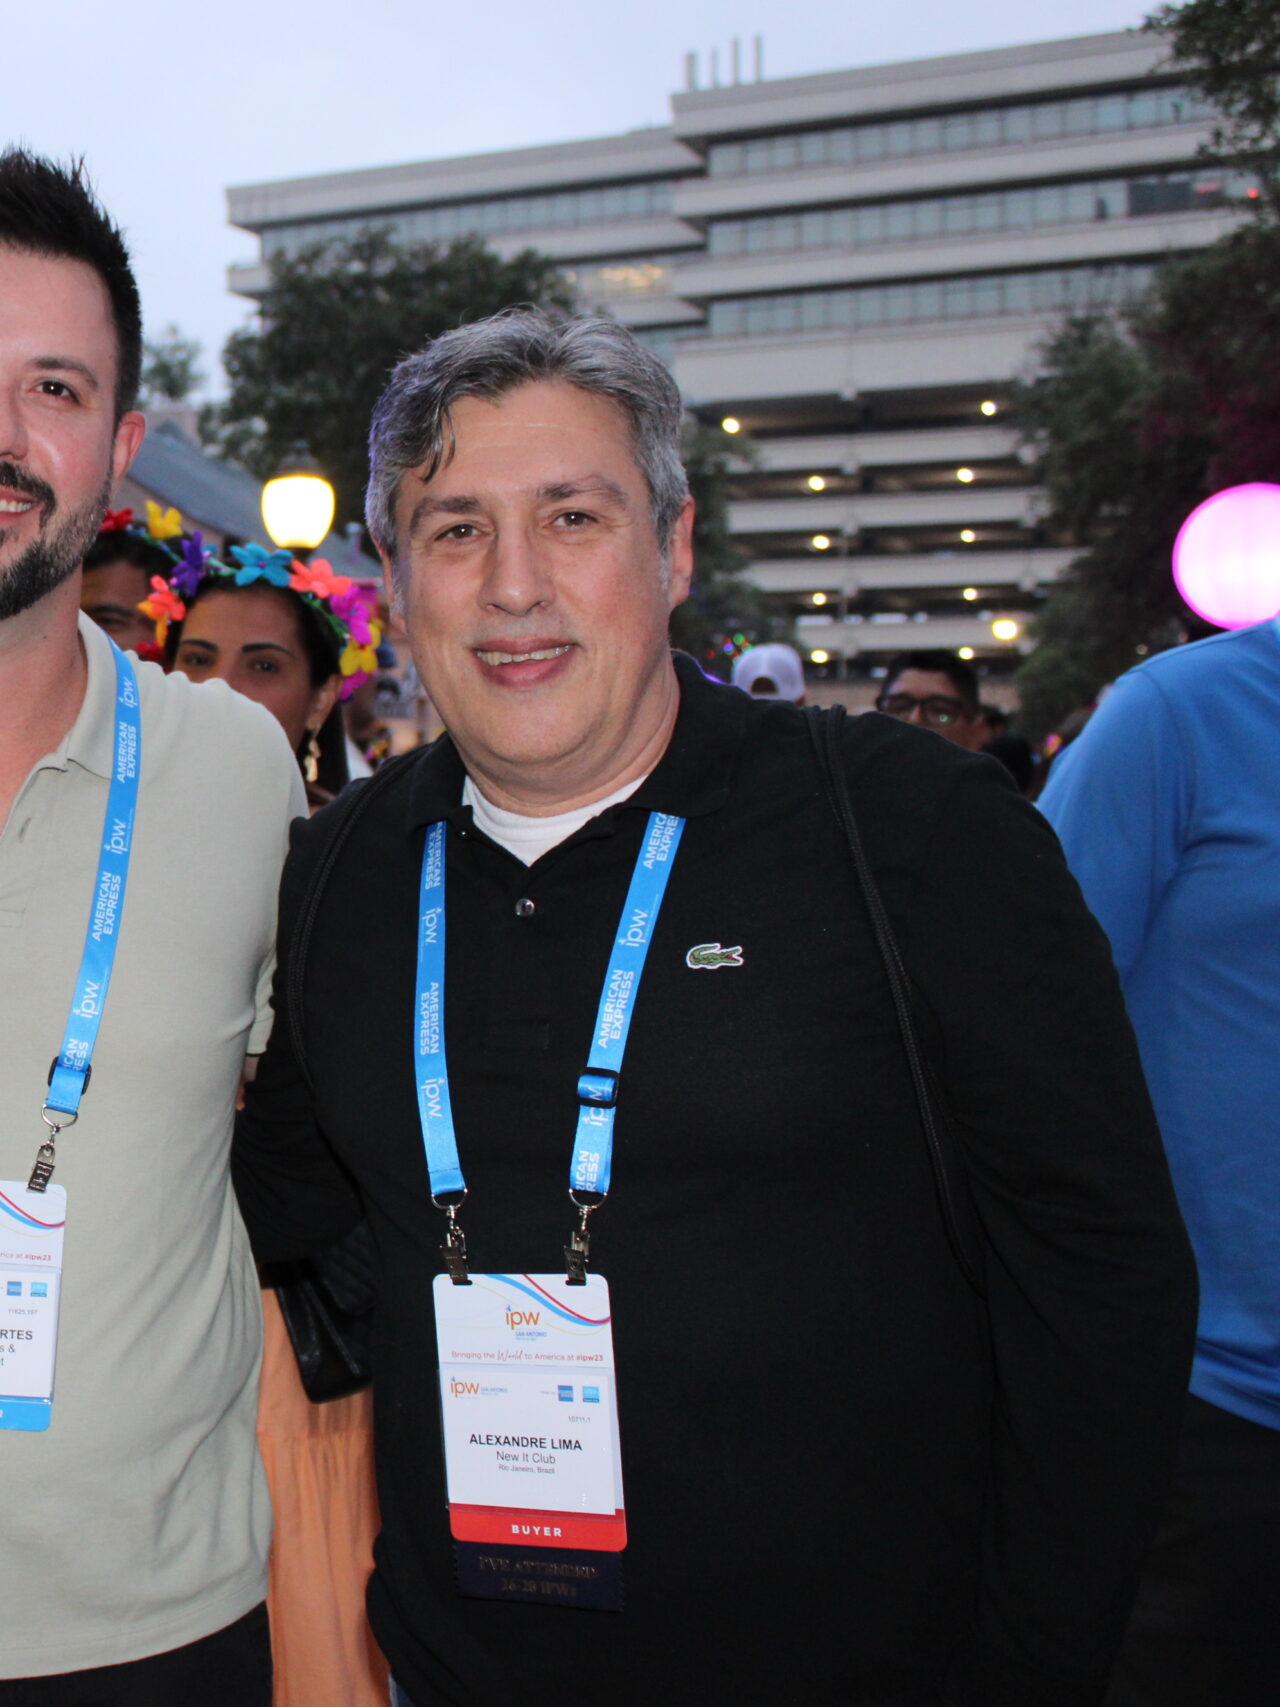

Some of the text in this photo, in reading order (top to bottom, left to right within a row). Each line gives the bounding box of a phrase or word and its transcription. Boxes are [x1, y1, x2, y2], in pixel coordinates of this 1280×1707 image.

[118, 676, 138, 709] ipw
[116, 722, 128, 784] AMERICAN
[126, 725, 137, 779] EXPRESS
[104, 819, 129, 855] ipw
[434, 821, 443, 887] AMERICAN
[643, 812, 668, 870] AMERICA
[424, 831, 436, 890] EXPRESS
[91, 871, 113, 942] AMERICAN
[102, 874, 122, 935] EXPRESS
[422, 907, 442, 944] ipw
[619, 908, 649, 948] ipw
[72, 980, 100, 1019] ipw
[429, 981, 439, 1055] AMERICAN
[597, 969, 624, 1049] AMERICAN
[610, 970, 635, 1040] EXPRESS
[420, 992, 430, 1056] EXPRESS
[420, 1078, 445, 1118] ipw
[576, 1150, 590, 1191] RICAN
[586, 1152, 600, 1192] RESS
[505, 1305, 540, 1330] ipw
[8, 1344, 16, 1353] &
[451, 1350, 480, 1361] Bringing
[481, 1351, 495, 1360] the
[524, 1352, 533, 1360] to
[534, 1352, 565, 1362] America
[567, 1353, 574, 1361] at
[450, 1377, 480, 1399] ipw
[469, 1433, 583, 1451] ALEXANDRE LIMA
[496, 1451, 556, 1464] New It Club
[511, 1524, 563, 1537] BUYER
